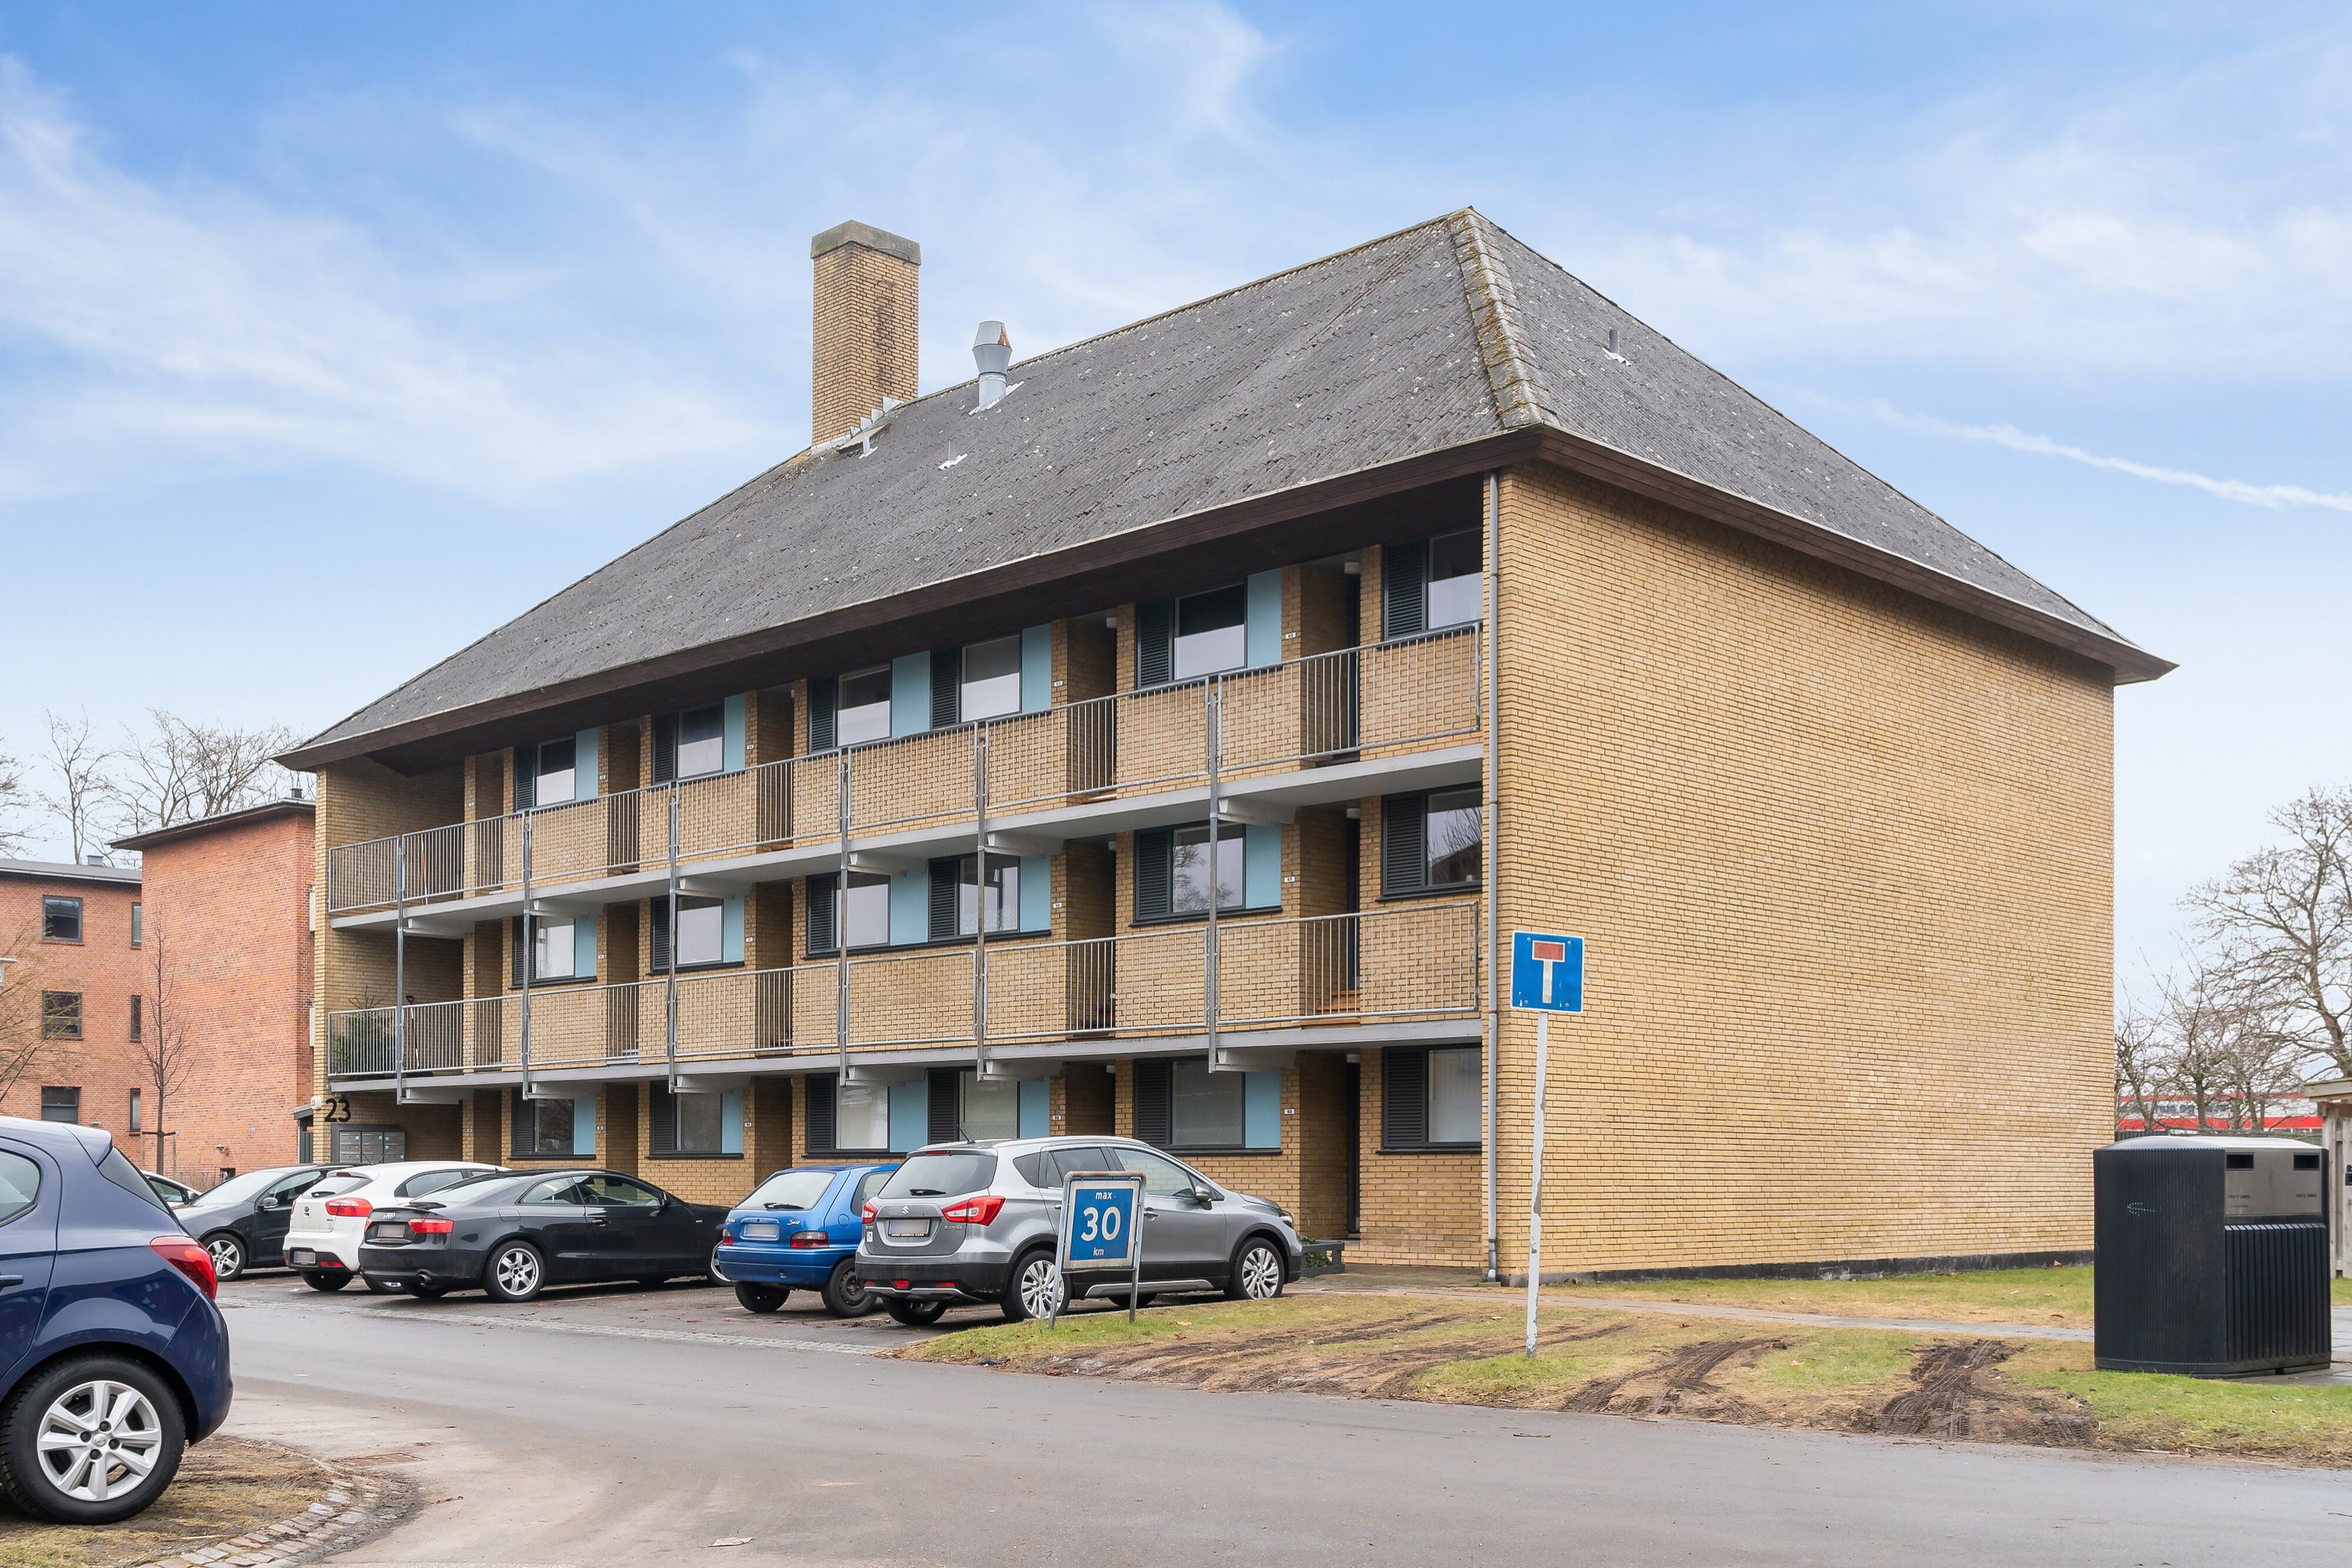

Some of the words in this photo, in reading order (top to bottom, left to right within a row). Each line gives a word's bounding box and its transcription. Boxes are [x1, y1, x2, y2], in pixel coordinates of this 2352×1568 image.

[325, 1098, 351, 1122] 23
[1080, 1206, 1121, 1242] 30
[1093, 1247, 1105, 1256] km
